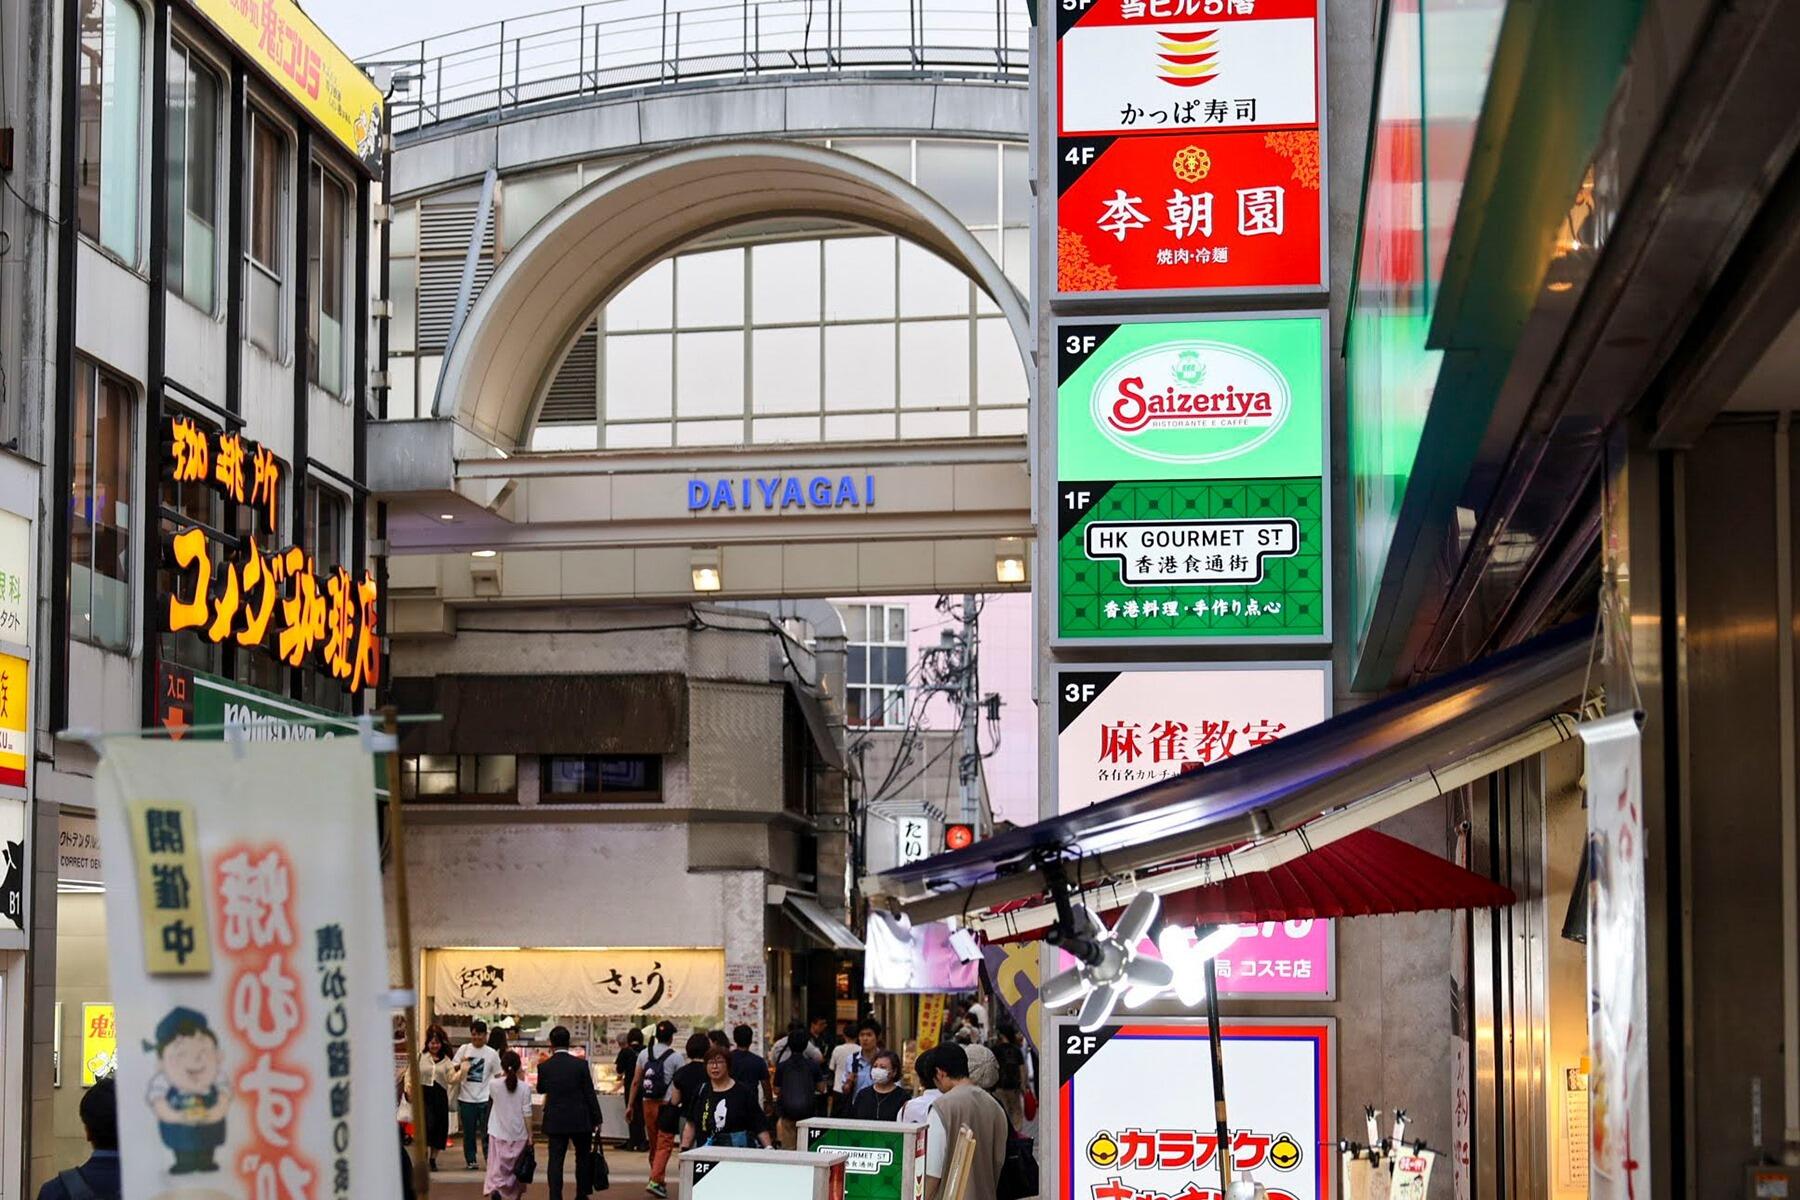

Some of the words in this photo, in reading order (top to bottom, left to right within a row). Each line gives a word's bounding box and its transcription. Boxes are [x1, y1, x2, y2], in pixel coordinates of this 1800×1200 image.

[1120, 97, 1257, 125] かっぱ寿司
[1064, 147, 1095, 165] 4F
[1096, 185, 1286, 242] 李朝園
[1066, 335, 1096, 354] 3F
[1109, 376, 1273, 431] Saizeriya
[1152, 420, 1208, 428] RISTORANTE
[688, 475, 876, 510] DAIYAGAI
[1064, 491, 1091, 510] 1F
[1100, 531, 1129, 548] HK
[1141, 530, 1245, 547] GOURMET
[1135, 553, 1250, 574] 香港食通街
[167, 674, 185, 701] 入口
[1065, 684, 1096, 703] 3F
[905, 821, 921, 864] たい
[9, 891, 20, 914] B1
[1241, 959, 1311, 978] コスモ店
[593, 961, 665, 1010] さとう
[1066, 1036, 1096, 1055] 2F
[810, 1130, 820, 1138] 1F
[1119, 1131, 1271, 1168] カラオケ
[695, 1163, 710, 1173] 2F
